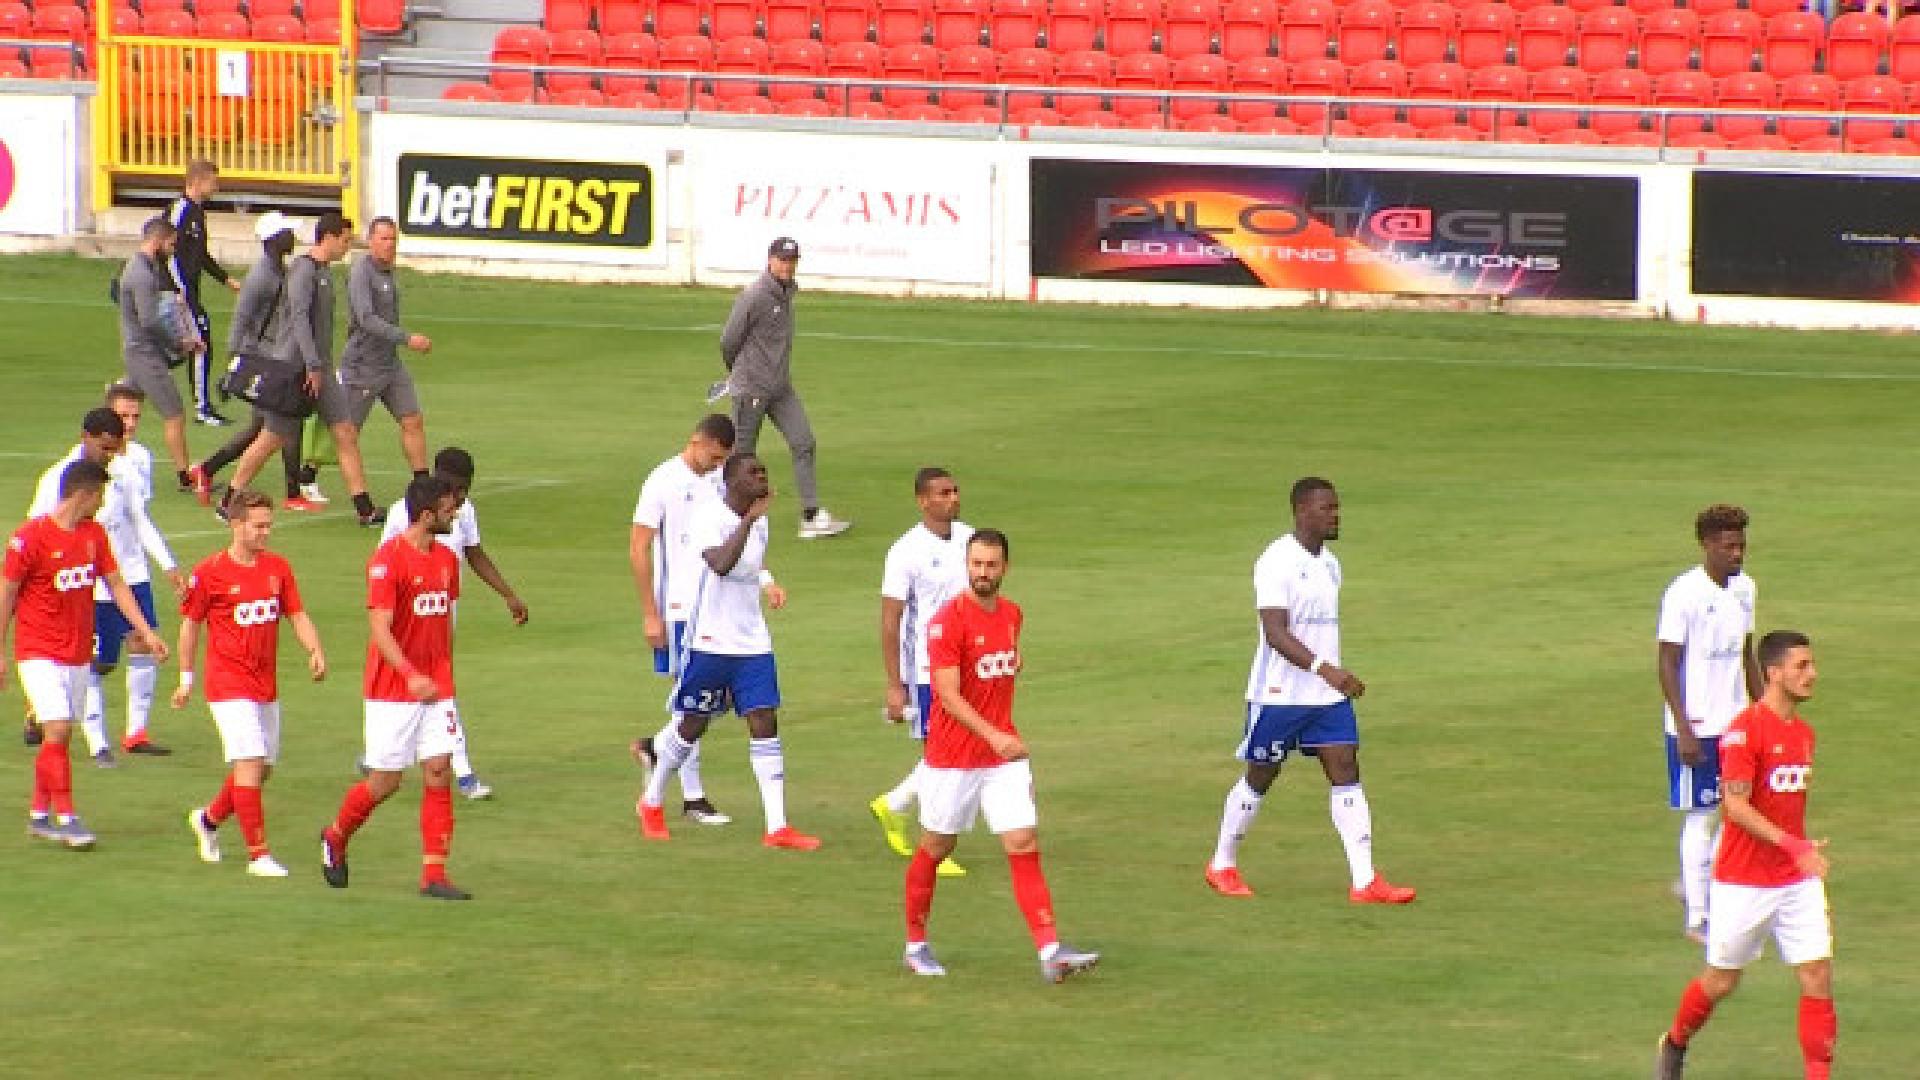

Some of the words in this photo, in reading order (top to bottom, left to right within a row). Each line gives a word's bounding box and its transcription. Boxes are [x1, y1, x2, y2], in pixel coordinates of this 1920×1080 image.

[406, 169, 641, 236] betFIRST
[1097, 197, 1567, 247] PILOT@GE
[1100, 239, 1168, 256] LED
[1178, 242, 1336, 263] LIGHTING
[1345, 249, 1561, 271] SOLUTIONS
[1269, 740, 1286, 763] 5
